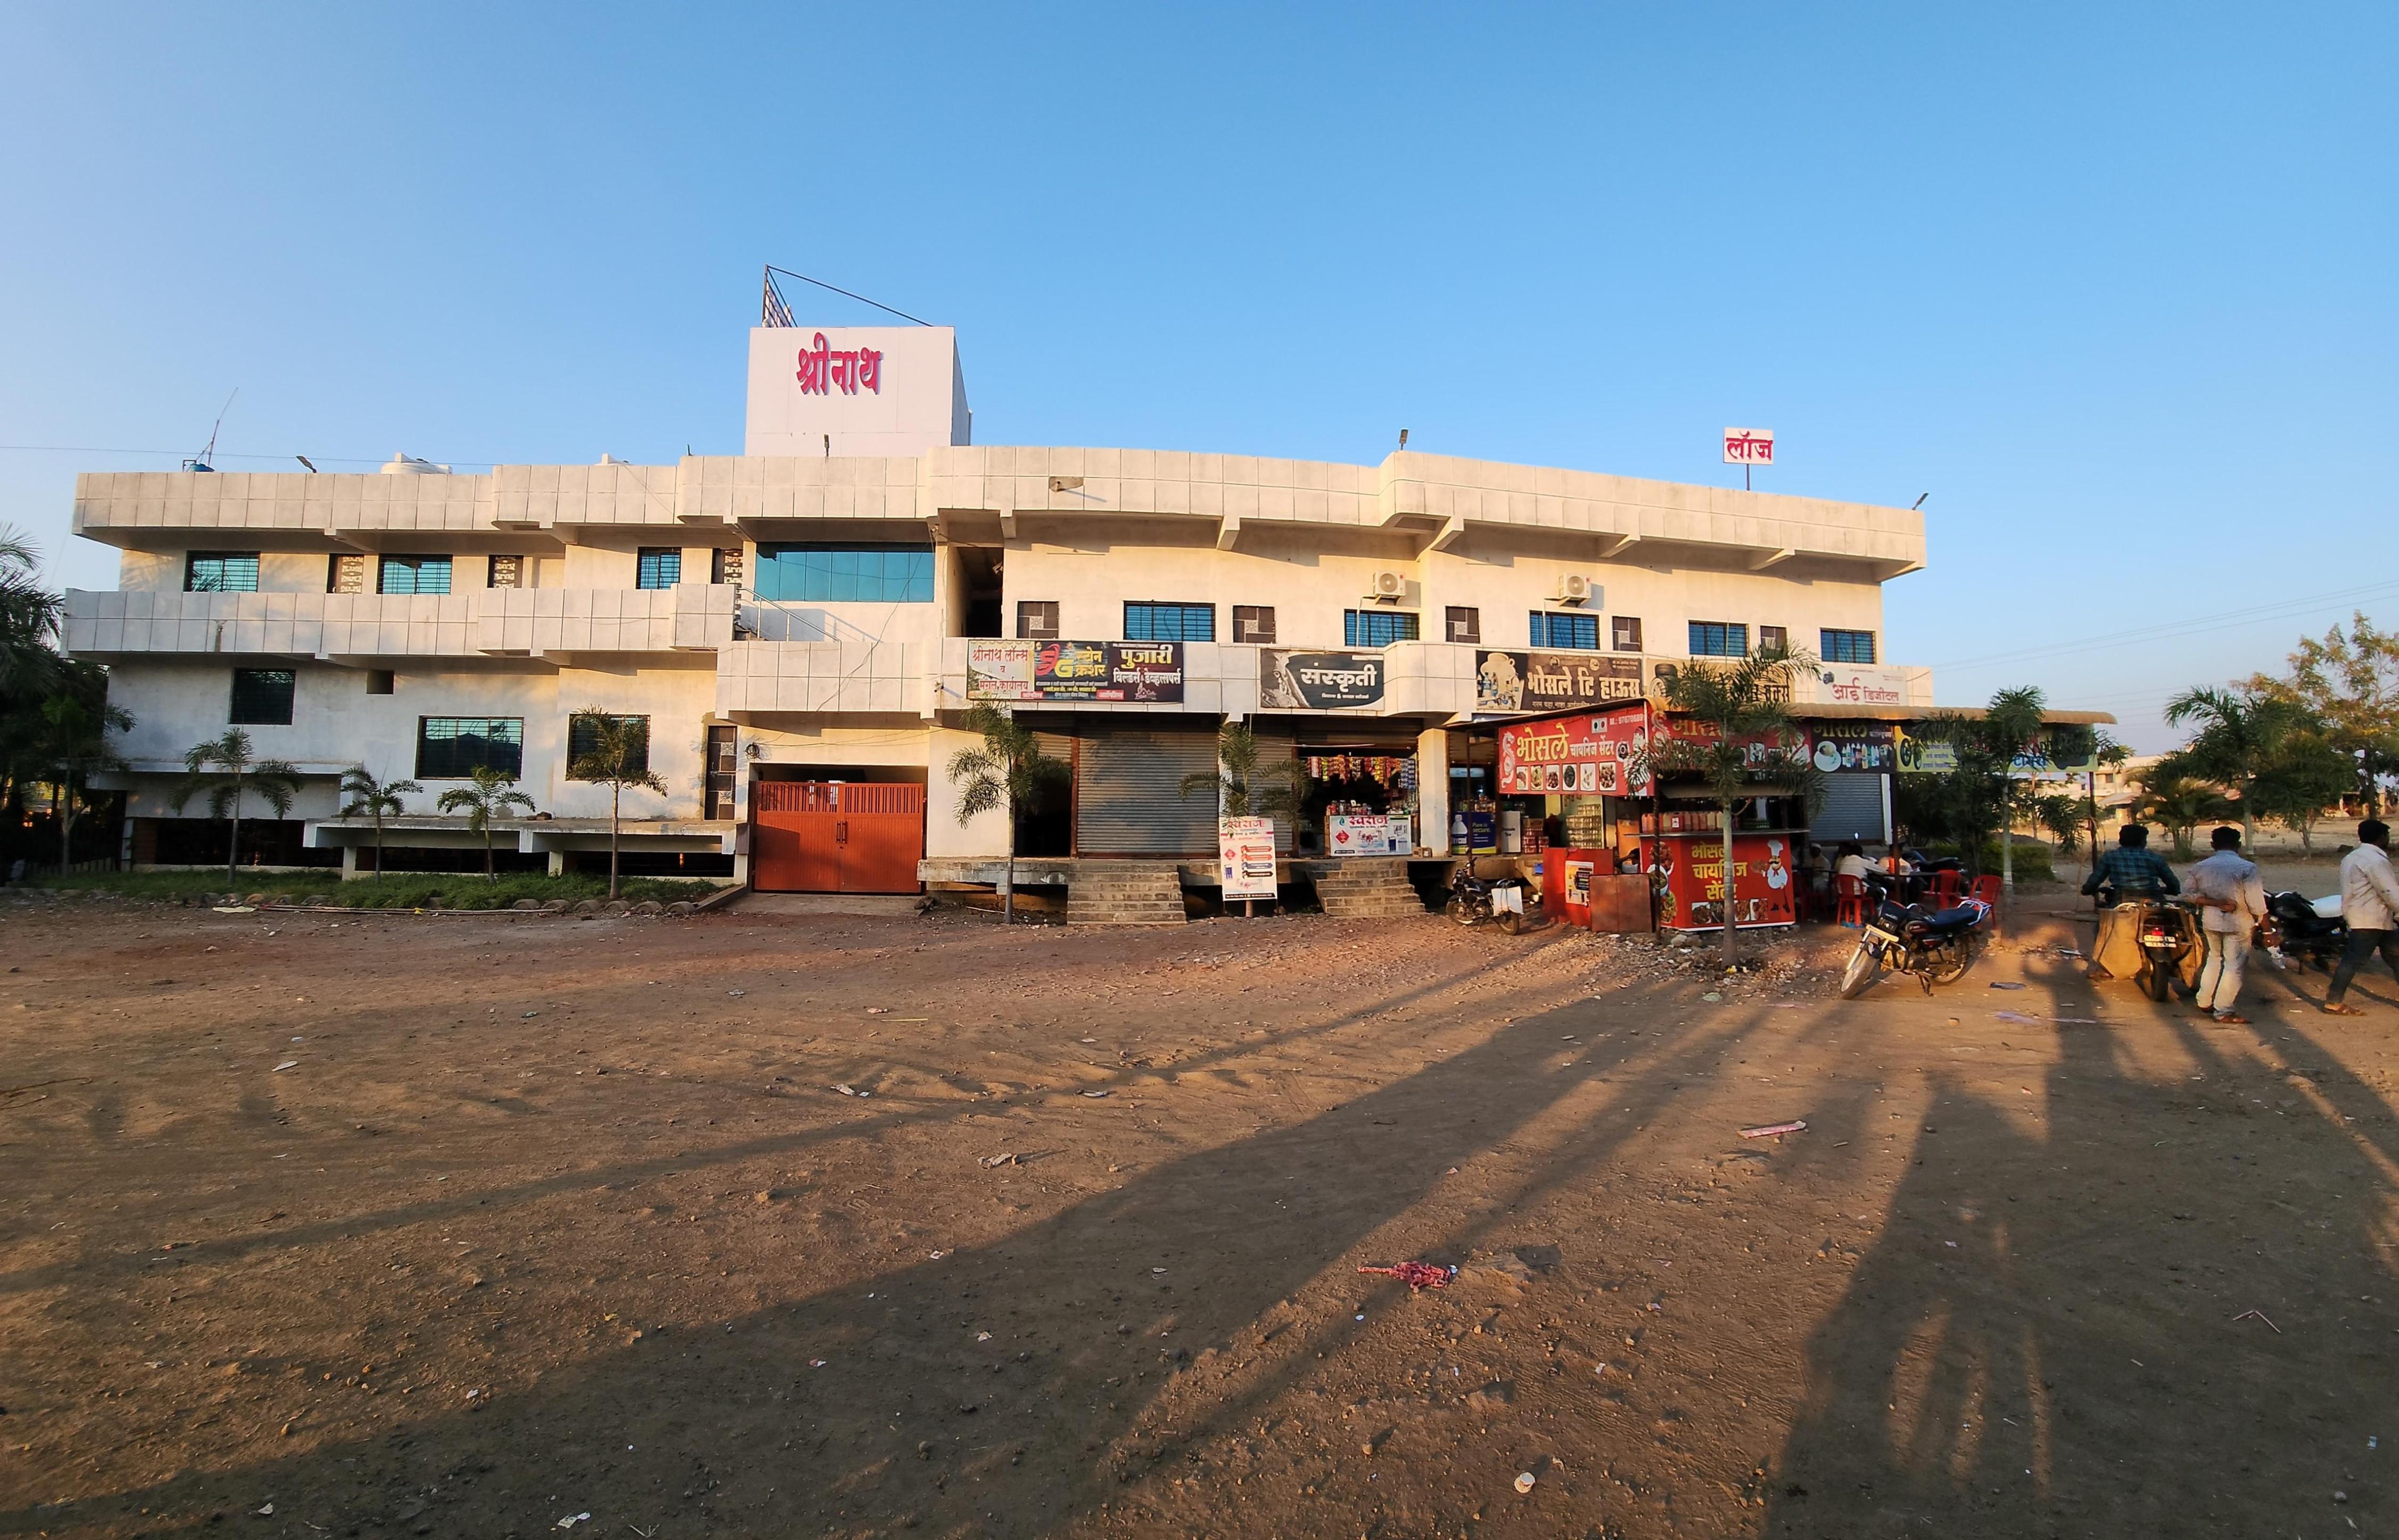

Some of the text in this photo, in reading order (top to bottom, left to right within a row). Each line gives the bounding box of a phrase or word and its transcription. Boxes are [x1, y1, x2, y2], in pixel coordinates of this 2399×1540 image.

[796, 332, 881, 395] श्रीनाथ
[1726, 430, 1773, 461] लॉज
[972, 645, 1028, 662] श्रीनाथ लॉन्स
[1120, 644, 1173, 669] पुजारी
[999, 676, 1029, 691] कार्यालय
[1113, 667, 1141, 684] बिल्डर्स
[1300, 662, 1378, 693] संस्कृती
[1527, 665, 1641, 699] भोसले टि हाऊस
[1832, 676, 1861, 702] आई
[1516, 722, 1569, 762] भोसले
[1691, 841, 1725, 859] भोसल
[1692, 859, 1748, 878] चायिज
[1704, 880, 1738, 900] सेंट
